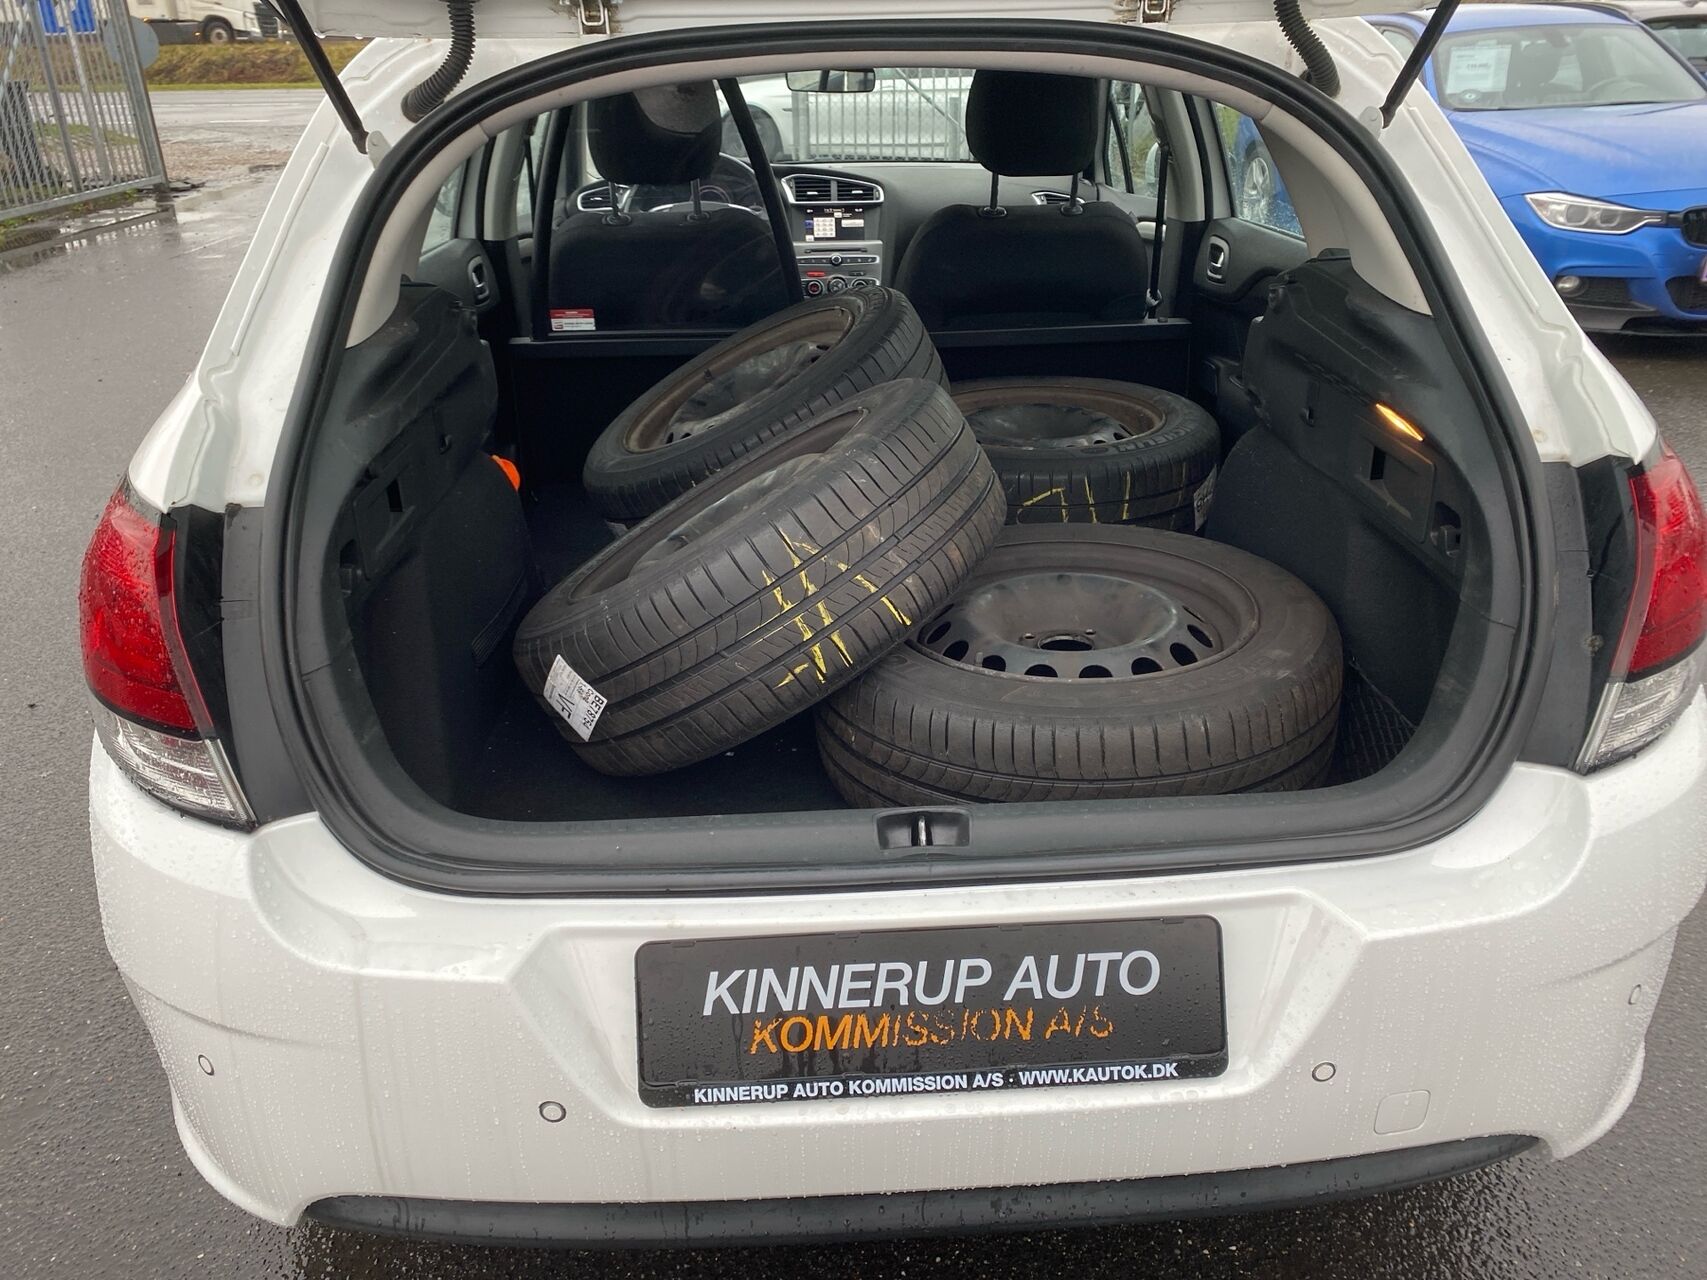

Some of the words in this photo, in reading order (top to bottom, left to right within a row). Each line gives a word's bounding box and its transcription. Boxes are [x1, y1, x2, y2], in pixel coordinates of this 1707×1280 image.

[702, 958, 993, 1016] KINNERUP
[1003, 950, 1161, 1001] AUTO
[750, 1007, 1034, 1055] KOMMISSION
[1044, 1004, 1114, 1040] A/S
[694, 1083, 789, 1104] KINNERUP
[792, 1081, 844, 1098] AUTO
[848, 1075, 968, 1096] KOMMISSION
[972, 1073, 1004, 1088] A/S
[1018, 1062, 1179, 1086] WWW.KAUTOK.DK
